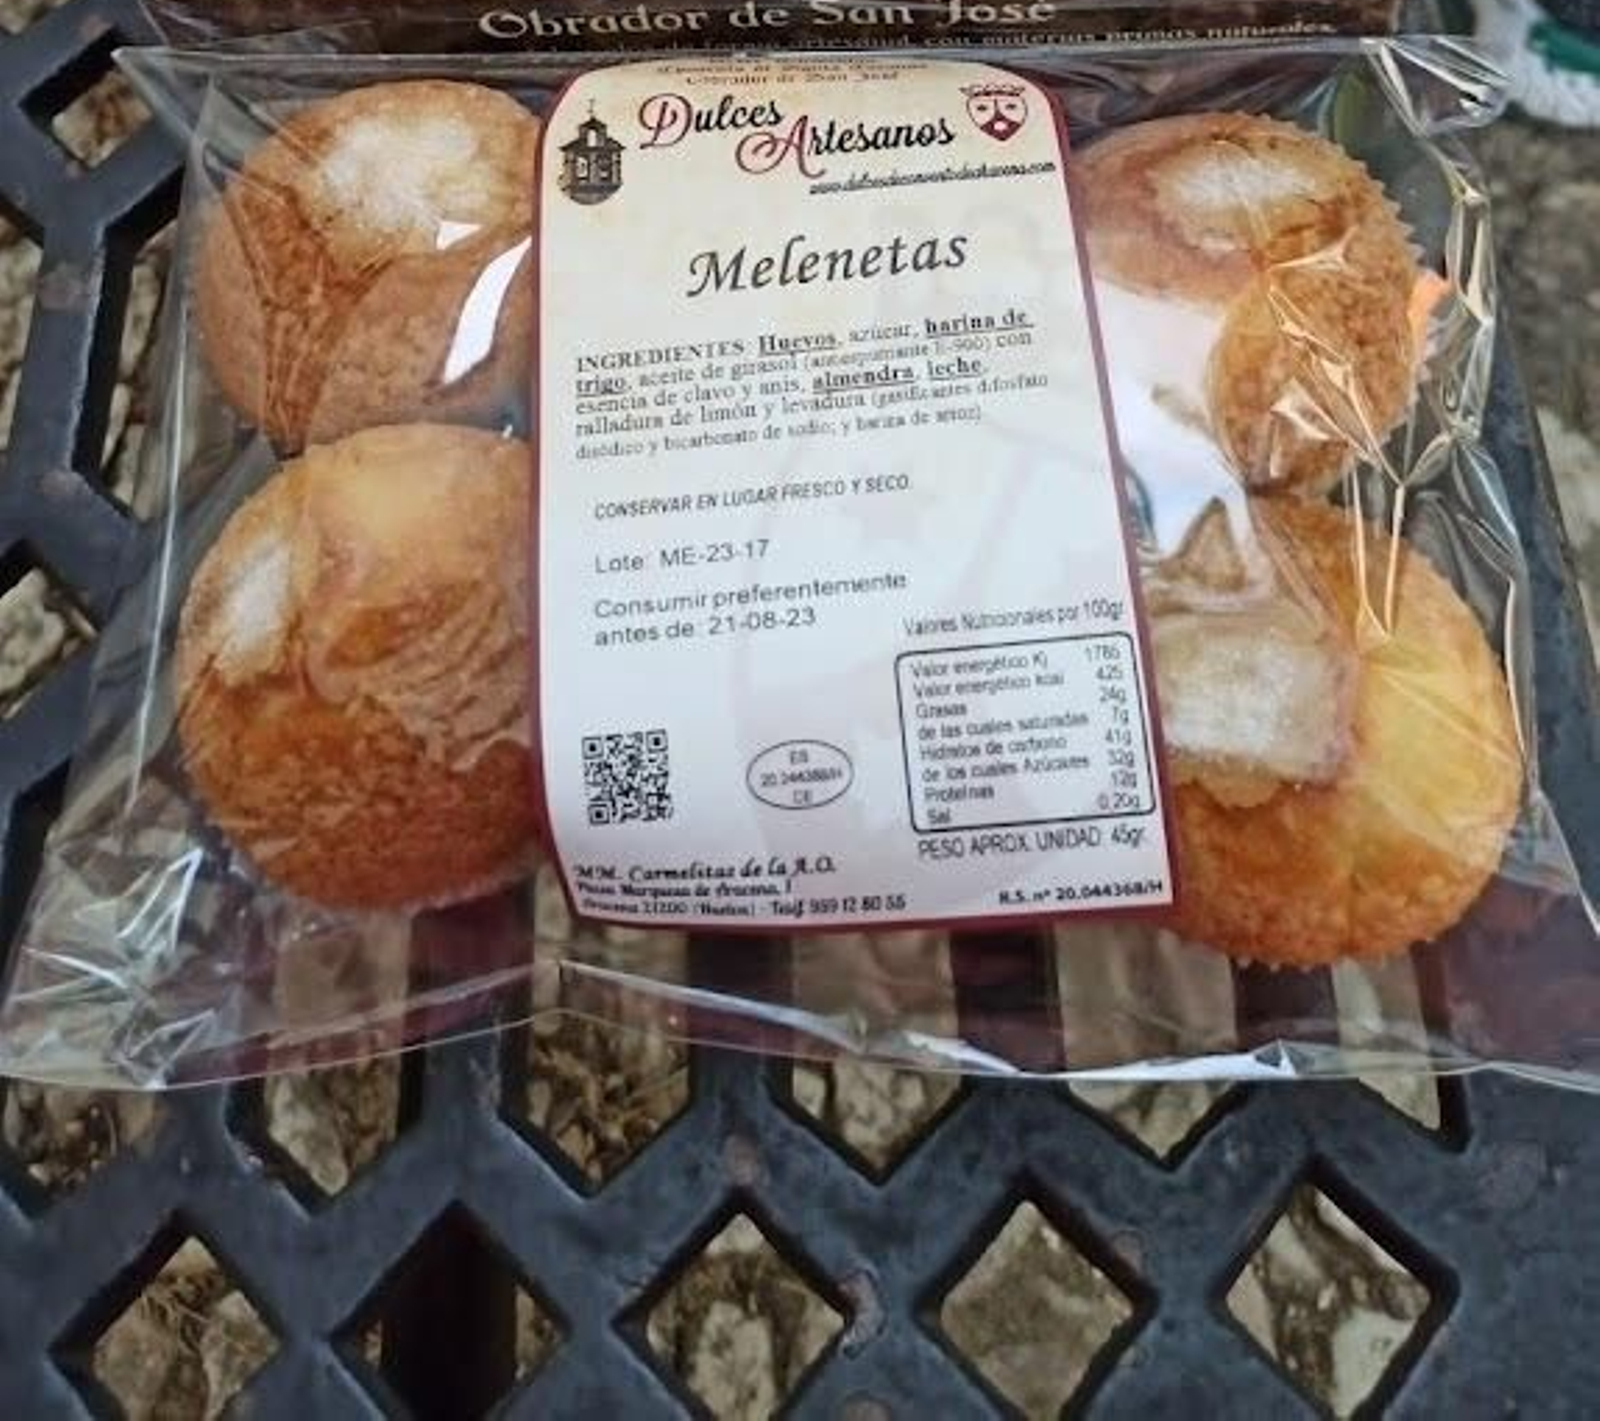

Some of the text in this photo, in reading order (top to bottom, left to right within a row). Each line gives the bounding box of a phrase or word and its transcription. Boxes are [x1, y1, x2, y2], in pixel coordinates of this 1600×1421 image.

[479, 2, 709, 39] Obrador
[728, 0, 790, 29] de
[639, 92, 956, 178] Dulces Artesanos
[687, 234, 968, 297] Melenetas
[924, 314, 996, 338] harina
[999, 308, 1034, 330] de
[639, 367, 696, 386] aceite
[707, 363, 724, 379] de
[731, 357, 797, 379] girasol
[996, 332, 1032, 348] con
[576, 396, 647, 415] esencia
[654, 389, 677, 407] de
[684, 384, 735, 404] clavo
[742, 383, 753, 399] y
[576, 415, 663, 437] ralladura
[670, 408, 696, 427] de
[701, 402, 757, 424] limón
[764, 403, 776, 420] y
[781, 390, 865, 416] levadura
[650, 441, 659, 458] y
[665, 428, 757, 451] bicarbonato
[763, 424, 780, 441] de
[842, 421, 851, 436] y
[857, 413, 905, 431] harina
[911, 410, 929, 426] de
[595, 496, 691, 521] CONSERVAR
[696, 493, 717, 510] EN
[723, 486, 778, 507] LUGAR
[781, 480, 845, 501] FRESCO
[851, 478, 860, 494] Y
[659, 539, 770, 568] ME-23-17
[595, 574, 907, 620] Consumir preferentemente
[595, 622, 659, 647] antes
[708, 606, 817, 635] 21-08-23
[903, 616, 958, 636] Valores
[1058, 605, 1079, 621] por
[910, 662, 950, 678] Valor
[954, 655, 1029, 676] energético
[913, 682, 951, 699] Valor
[955, 677, 1031, 696] energético
[915, 703, 967, 719] Grasas
[918, 725, 936, 740] de
[966, 719, 1013, 736] cuales
[920, 744, 981, 761] Hidratos
[986, 740, 1003, 755] de
[921, 767, 940, 783] de
[971, 760, 1017, 778] cuales
[927, 810, 952, 825] Sal
[918, 836, 964, 860] PESO
[1036, 827, 1102, 852] UNIDAD
[628, 861, 736, 882] Carmelitas
[740, 857, 762, 878] de
[768, 856, 787, 876] la
